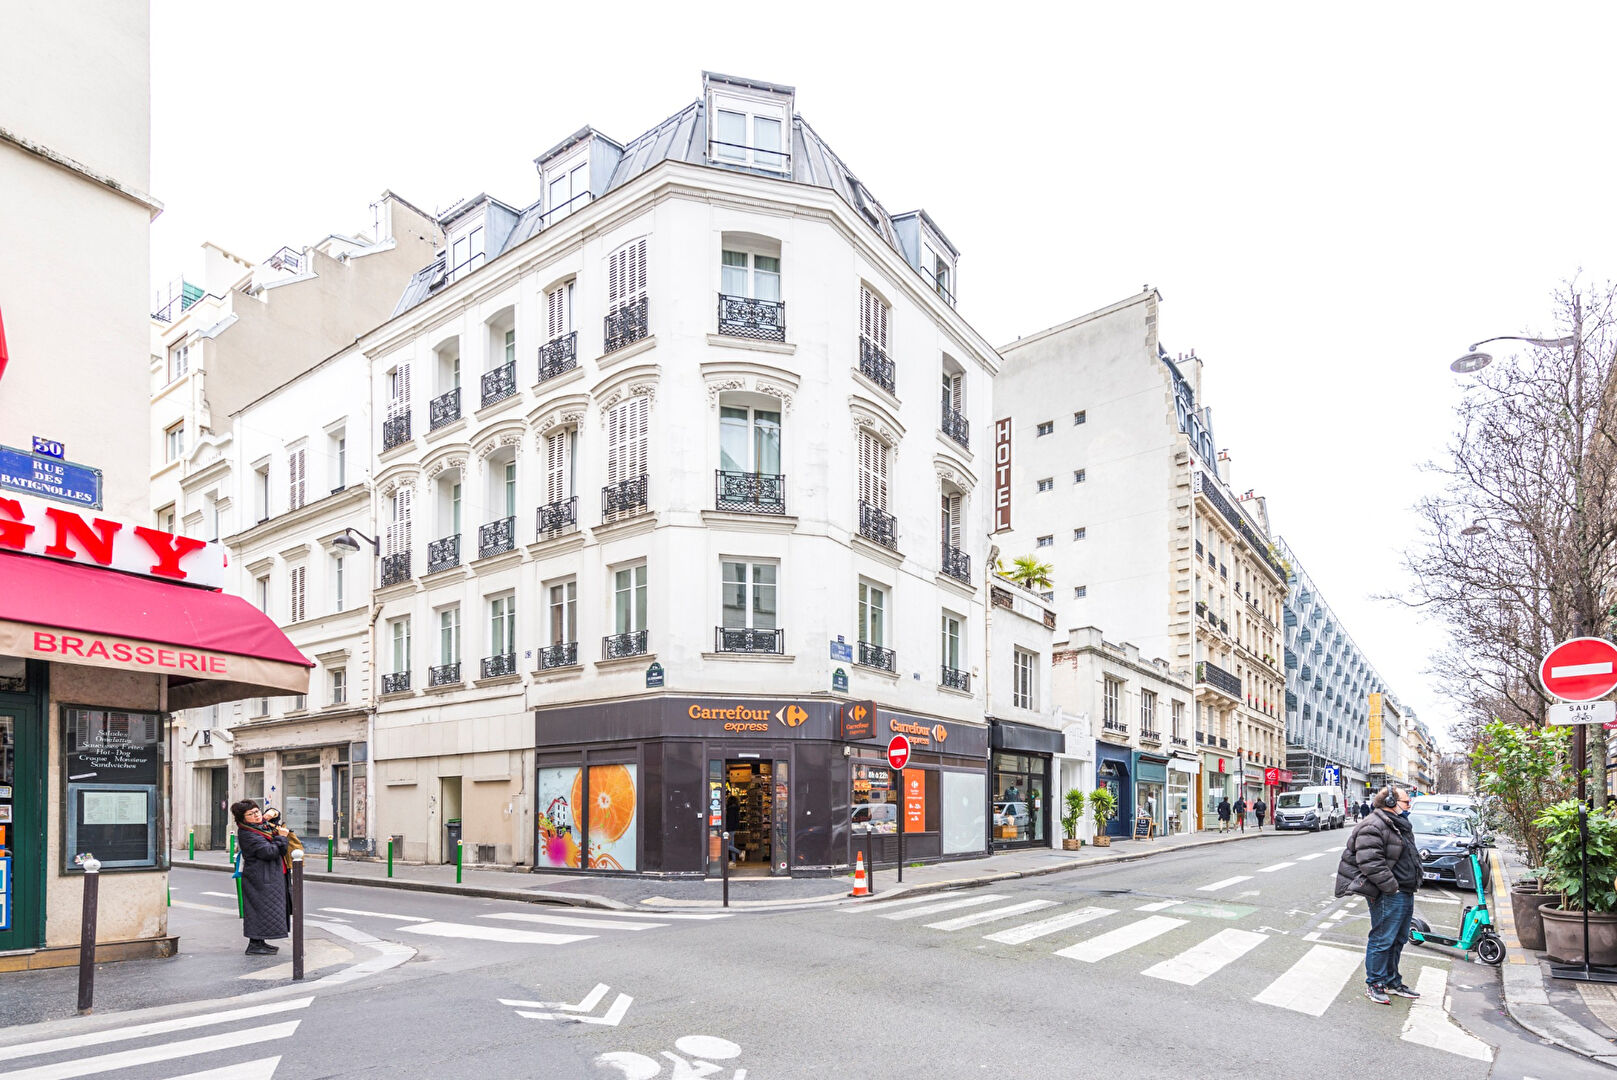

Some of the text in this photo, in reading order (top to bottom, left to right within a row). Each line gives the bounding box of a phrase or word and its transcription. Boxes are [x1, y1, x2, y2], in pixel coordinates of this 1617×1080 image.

[34, 438, 62, 456] 50
[33, 460, 64, 476] RUE
[997, 420, 1010, 530] HOTEL
[34, 471, 63, 485] DES
[1, 473, 93, 502] BATIGNOLLES
[33, 631, 228, 674] BRASSERIE
[688, 704, 771, 721] Carrefour
[724, 722, 769, 733] express
[890, 719, 930, 736] Carrefour
[908, 736, 930, 746] express
[79, 754, 148, 764] Croque Monsieur
[90, 761, 137, 769] Sandwiches
